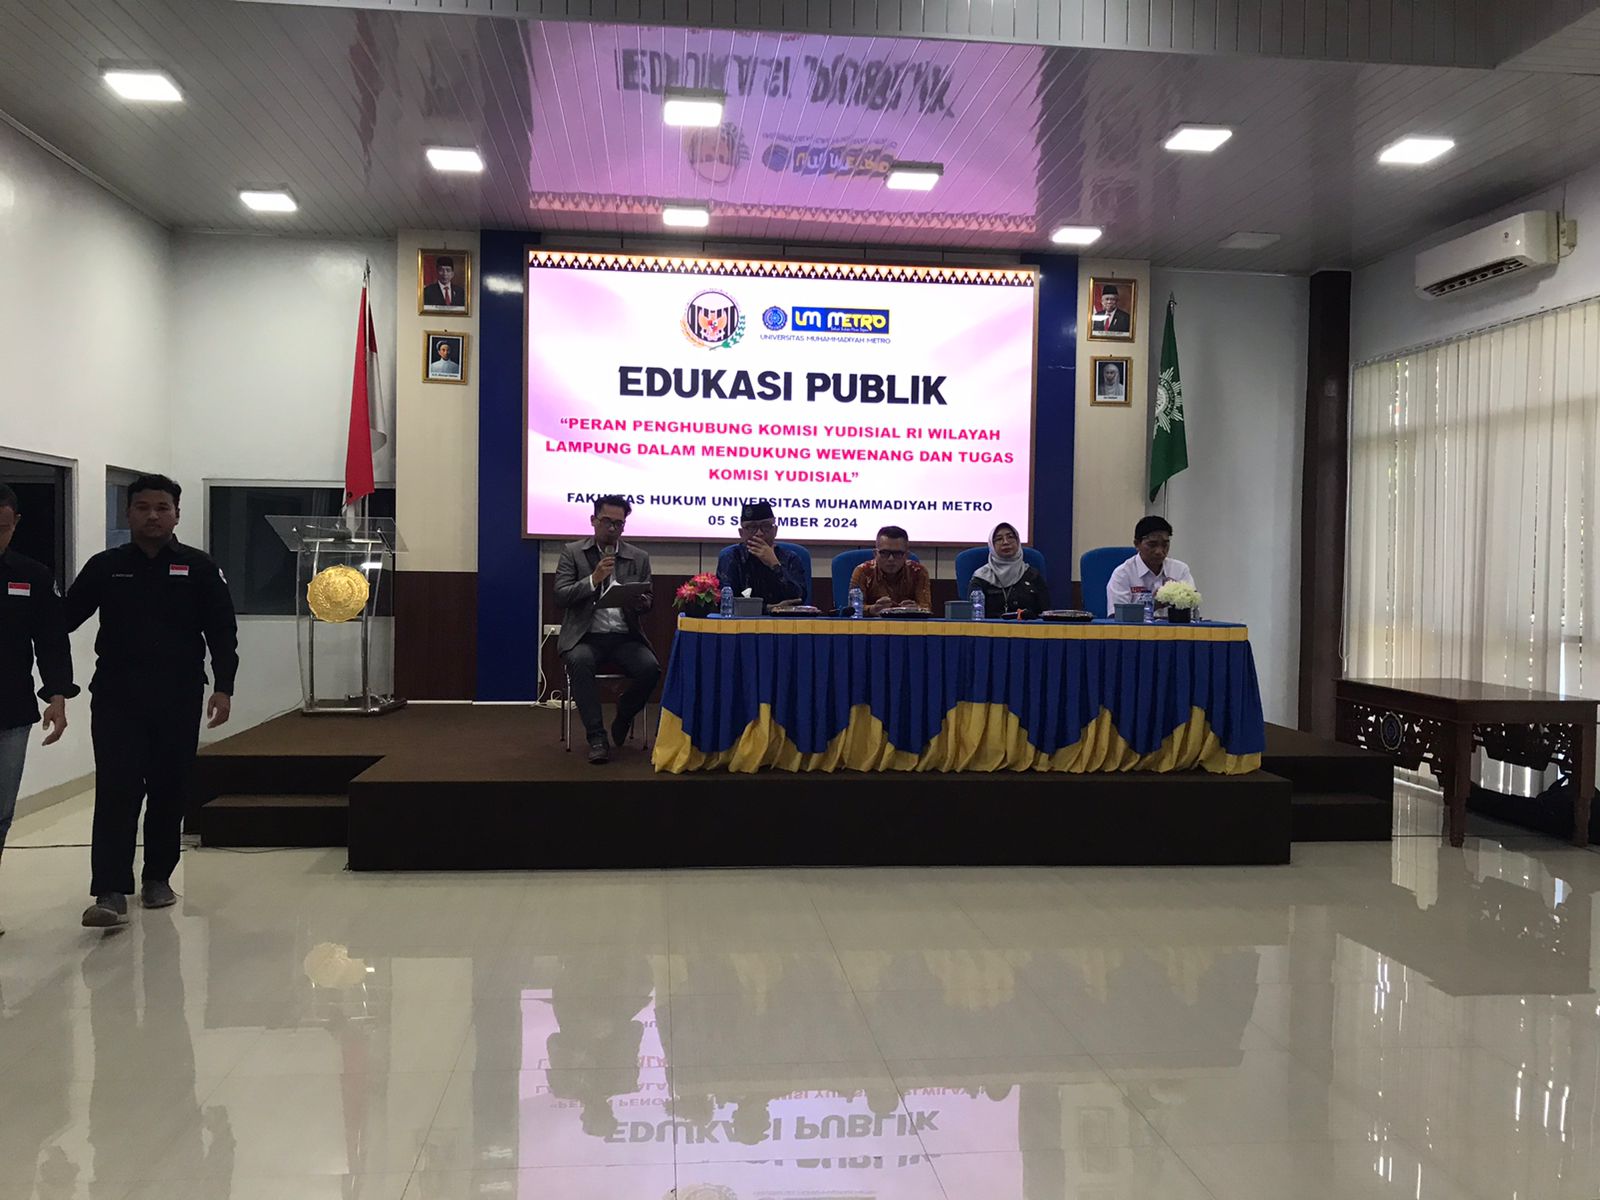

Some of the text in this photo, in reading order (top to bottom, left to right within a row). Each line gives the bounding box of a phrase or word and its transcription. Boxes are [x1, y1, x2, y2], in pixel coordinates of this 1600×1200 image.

[795, 310, 887, 331] UM METRO
[760, 334, 891, 345] UNIVERSITAS MUHAMMADIYAH METRO
[618, 365, 948, 405] EDUKASI PUBLIK
[633, 420, 752, 435] PENGHUBUNG
[758, 424, 818, 437] KOMISI
[824, 425, 901, 438] YUDISIAL
[906, 427, 923, 439] RI
[928, 428, 1001, 441] WILAYAH
[545, 440, 1014, 464] LAMPUNG DALAM MENDUKUNG WEWENANG DAN TUGAS
[708, 468, 769, 481] KOMISI
[567, 492, 645, 505] FAKAS
[650, 495, 707, 506] HUKUM
[815, 498, 937, 511] MUHAMMADIYAH
[942, 501, 993, 512] METRO
[708, 515, 858, 528] 05 SMBER 2024
